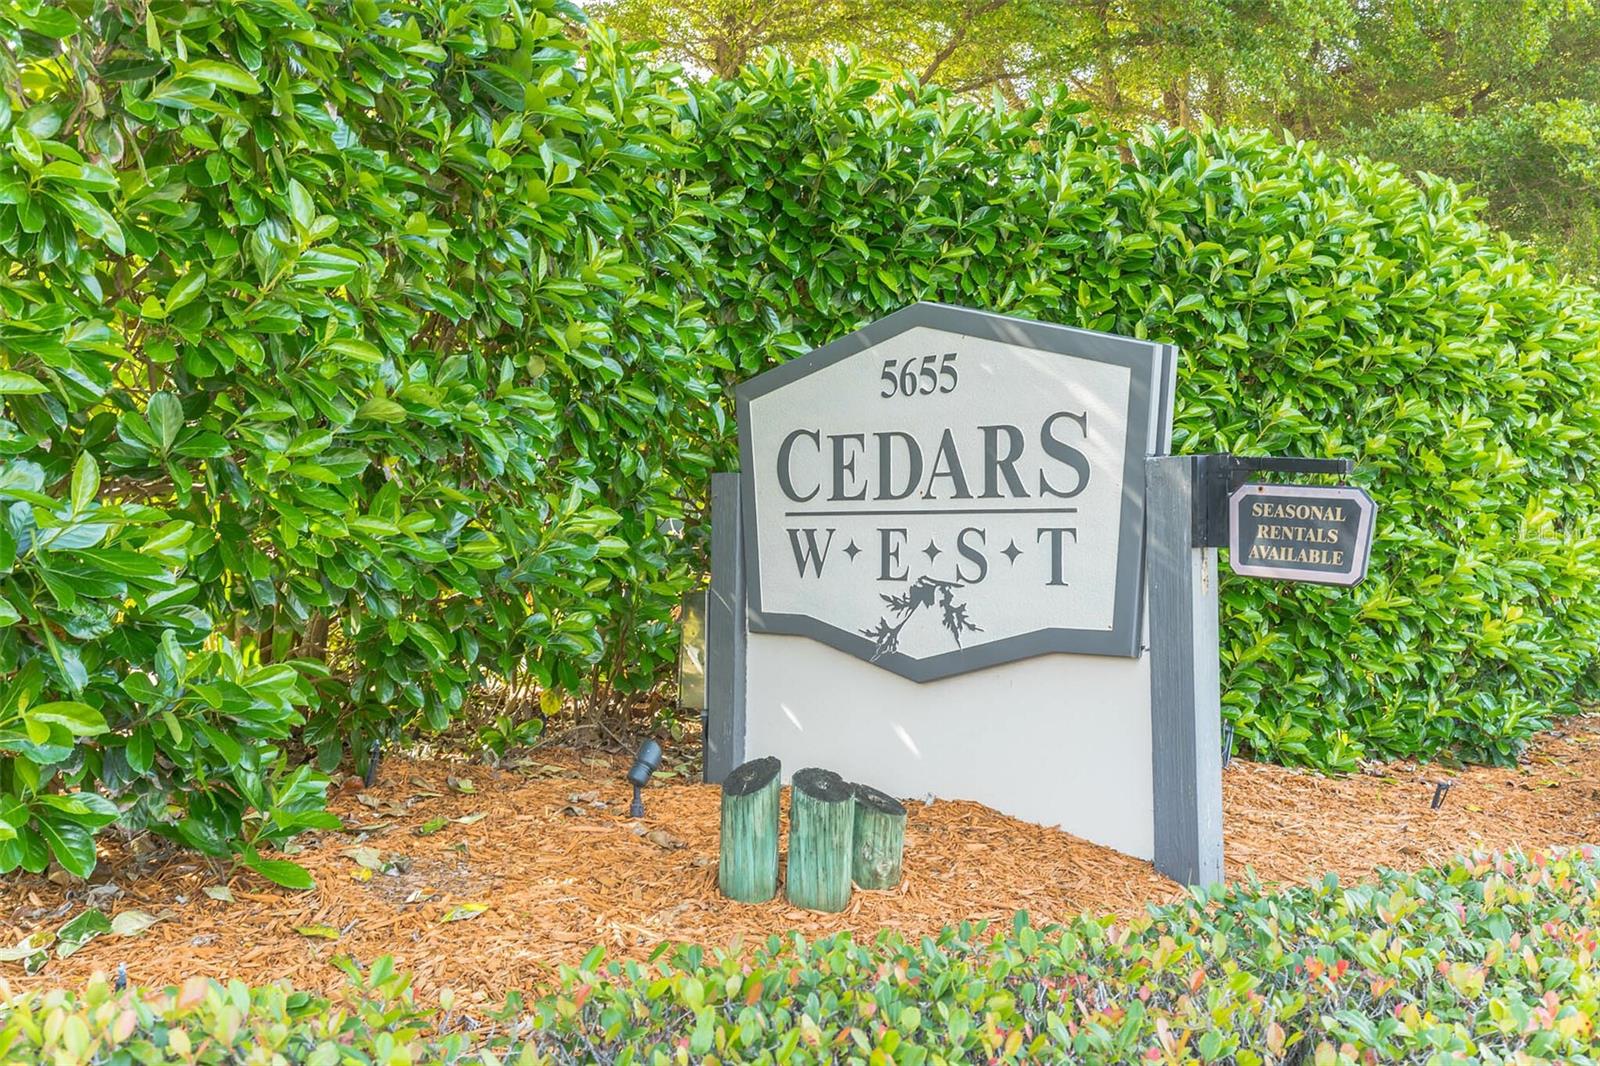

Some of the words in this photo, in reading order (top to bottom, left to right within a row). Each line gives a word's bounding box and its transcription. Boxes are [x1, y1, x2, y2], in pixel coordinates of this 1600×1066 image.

[880, 352, 958, 399] 5655
[776, 411, 1091, 503] CEDARS
[1252, 502, 1346, 522] SEASONAL
[1256, 524, 1339, 544] RENTALS
[1248, 544, 1344, 566] AVAILABLE
